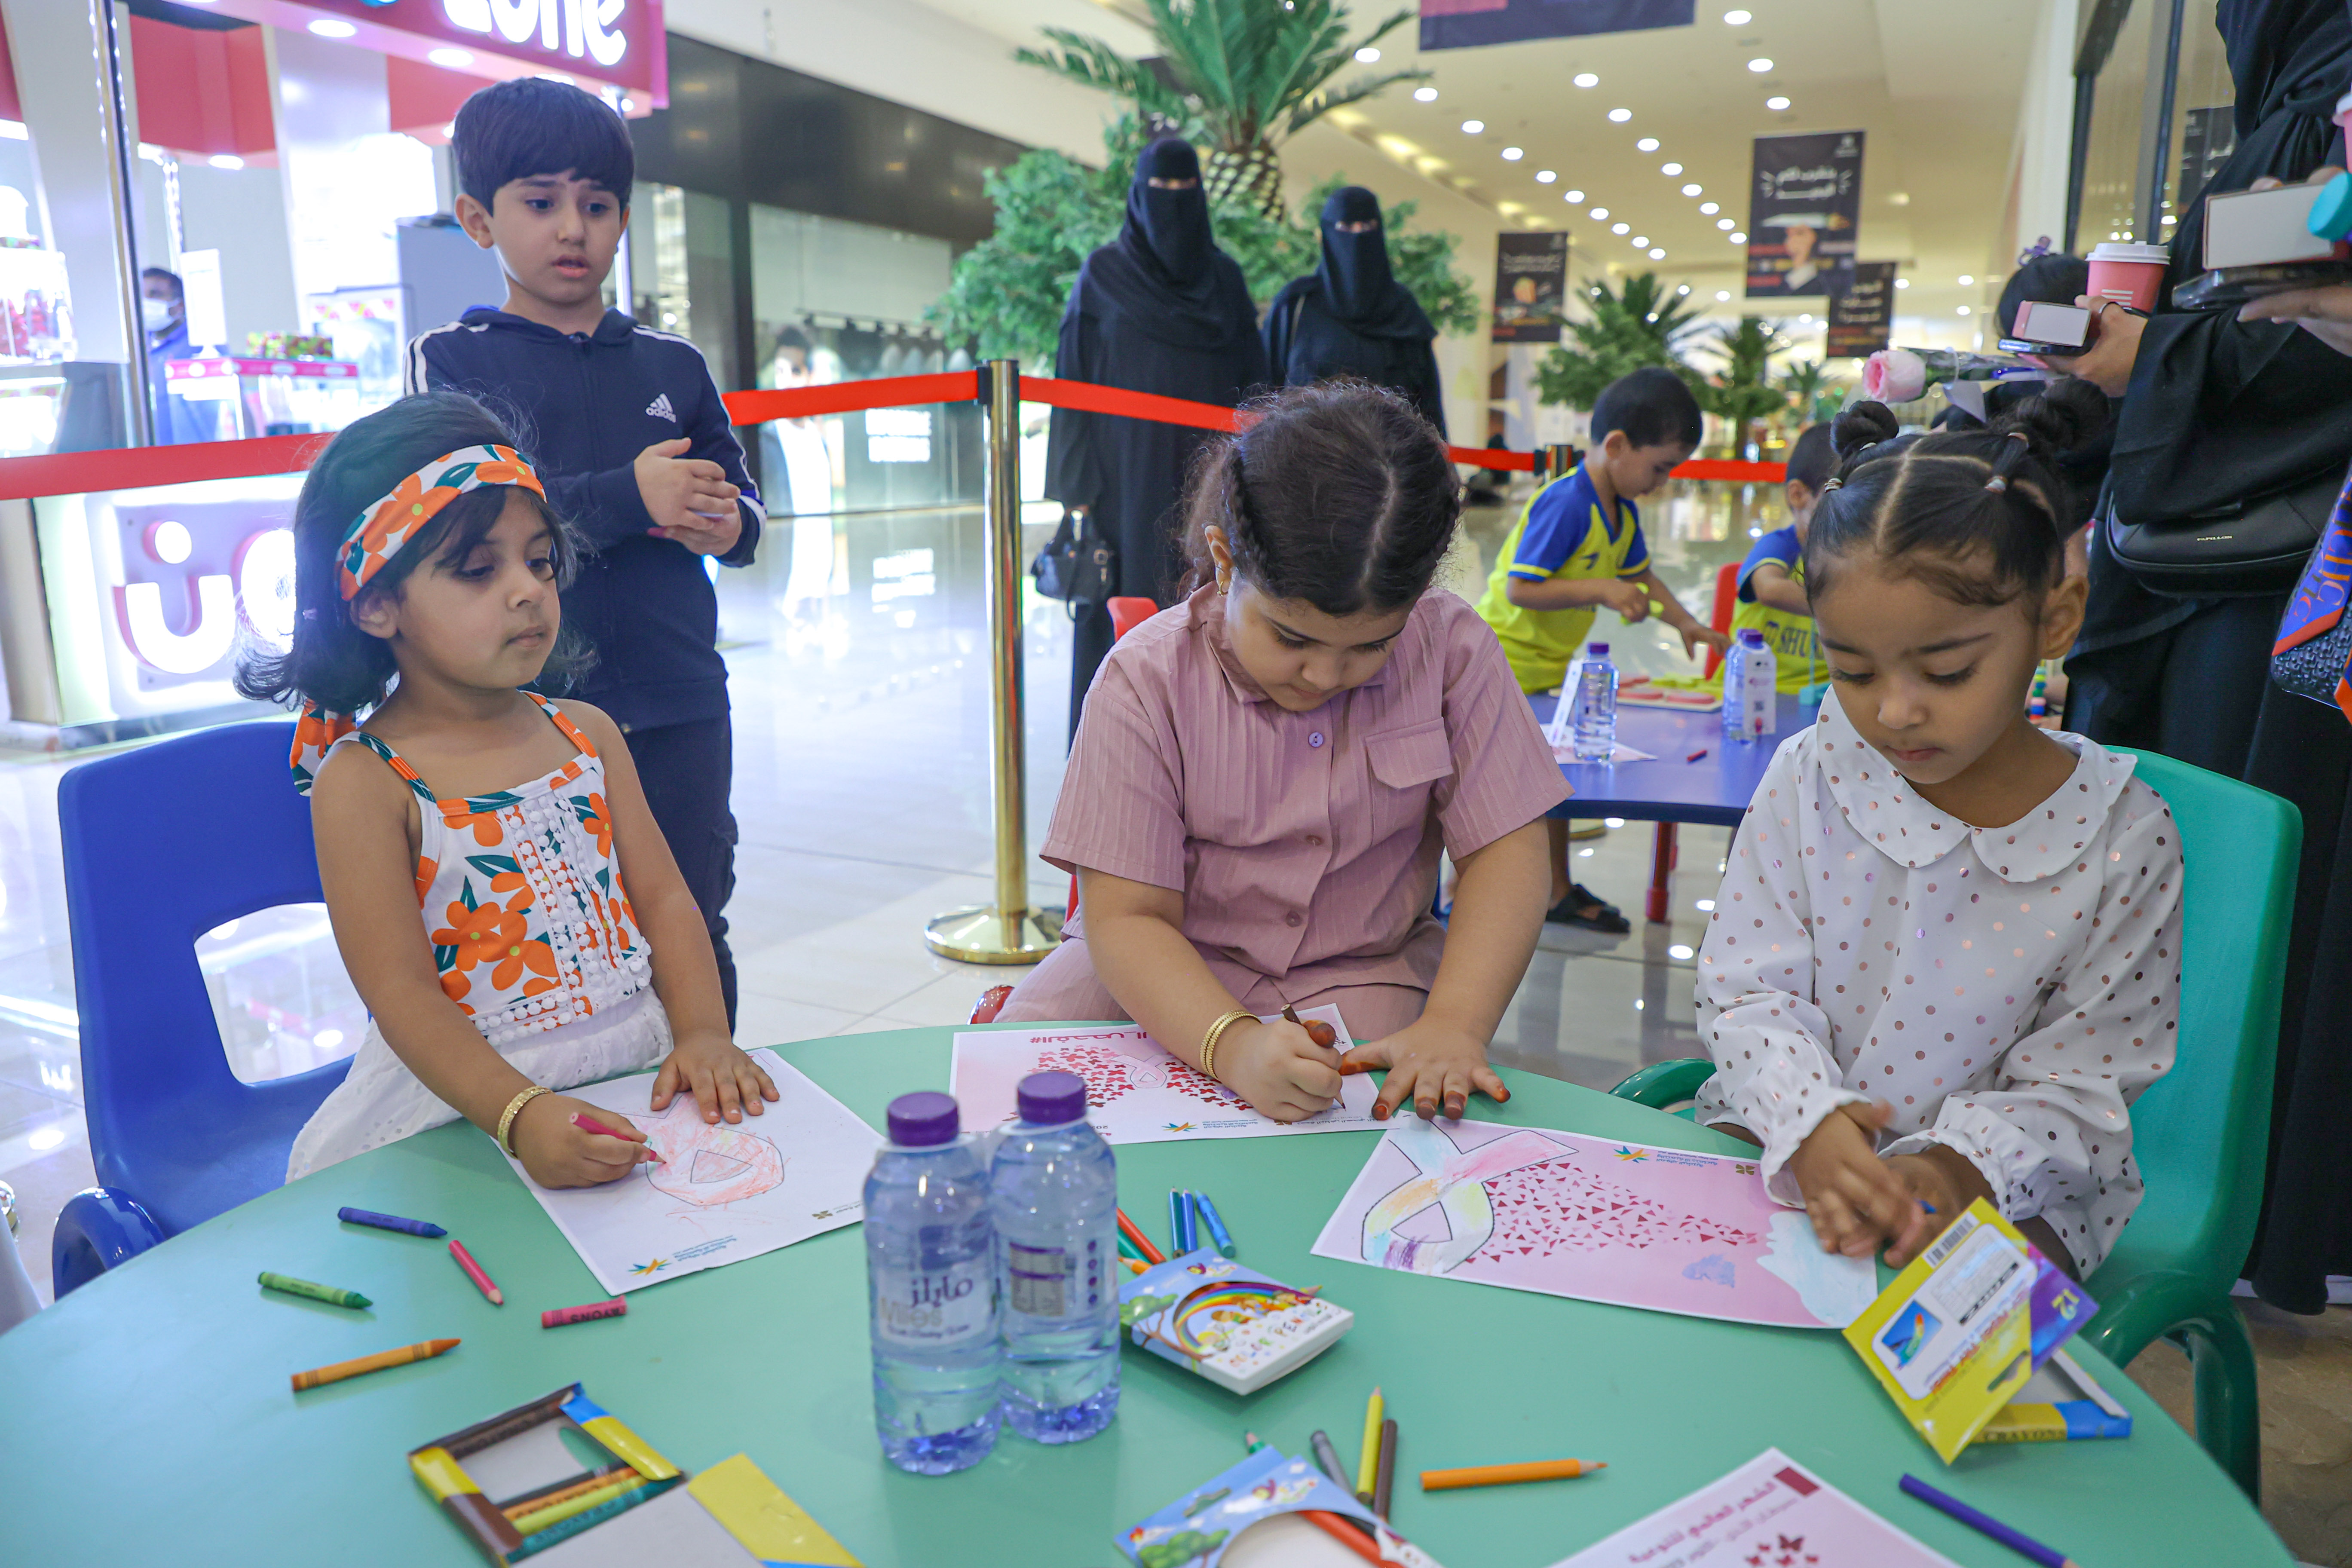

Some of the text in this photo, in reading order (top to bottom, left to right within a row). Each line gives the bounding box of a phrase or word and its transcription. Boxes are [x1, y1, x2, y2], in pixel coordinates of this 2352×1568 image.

[1029, 1031, 1148, 1044] #الفحص_ال
[910, 1275, 973, 1308] مايلز
[570, 1308, 622, 1324] AYONS
[2051, 1289, 2080, 1320] 12
